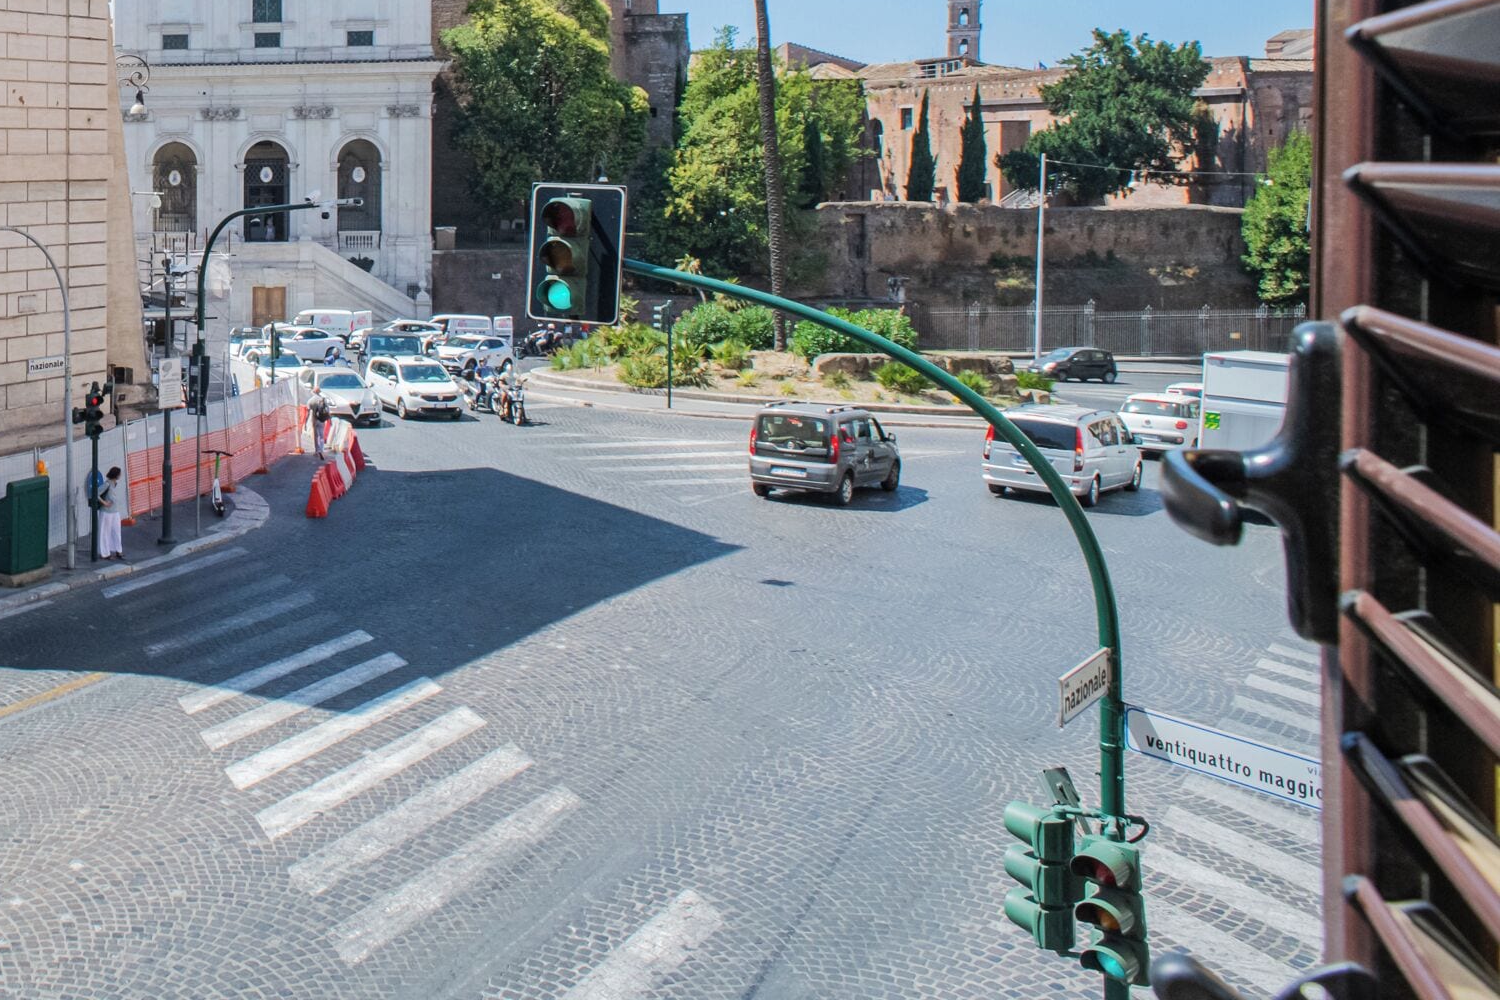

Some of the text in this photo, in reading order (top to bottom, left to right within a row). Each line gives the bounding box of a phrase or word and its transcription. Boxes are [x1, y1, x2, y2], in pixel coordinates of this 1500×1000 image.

[30, 359, 64, 371] nazionale
[1064, 666, 1107, 714] nazionale
[1146, 734, 1252, 777] ventiquattro
[1307, 766, 1321, 777] vi
